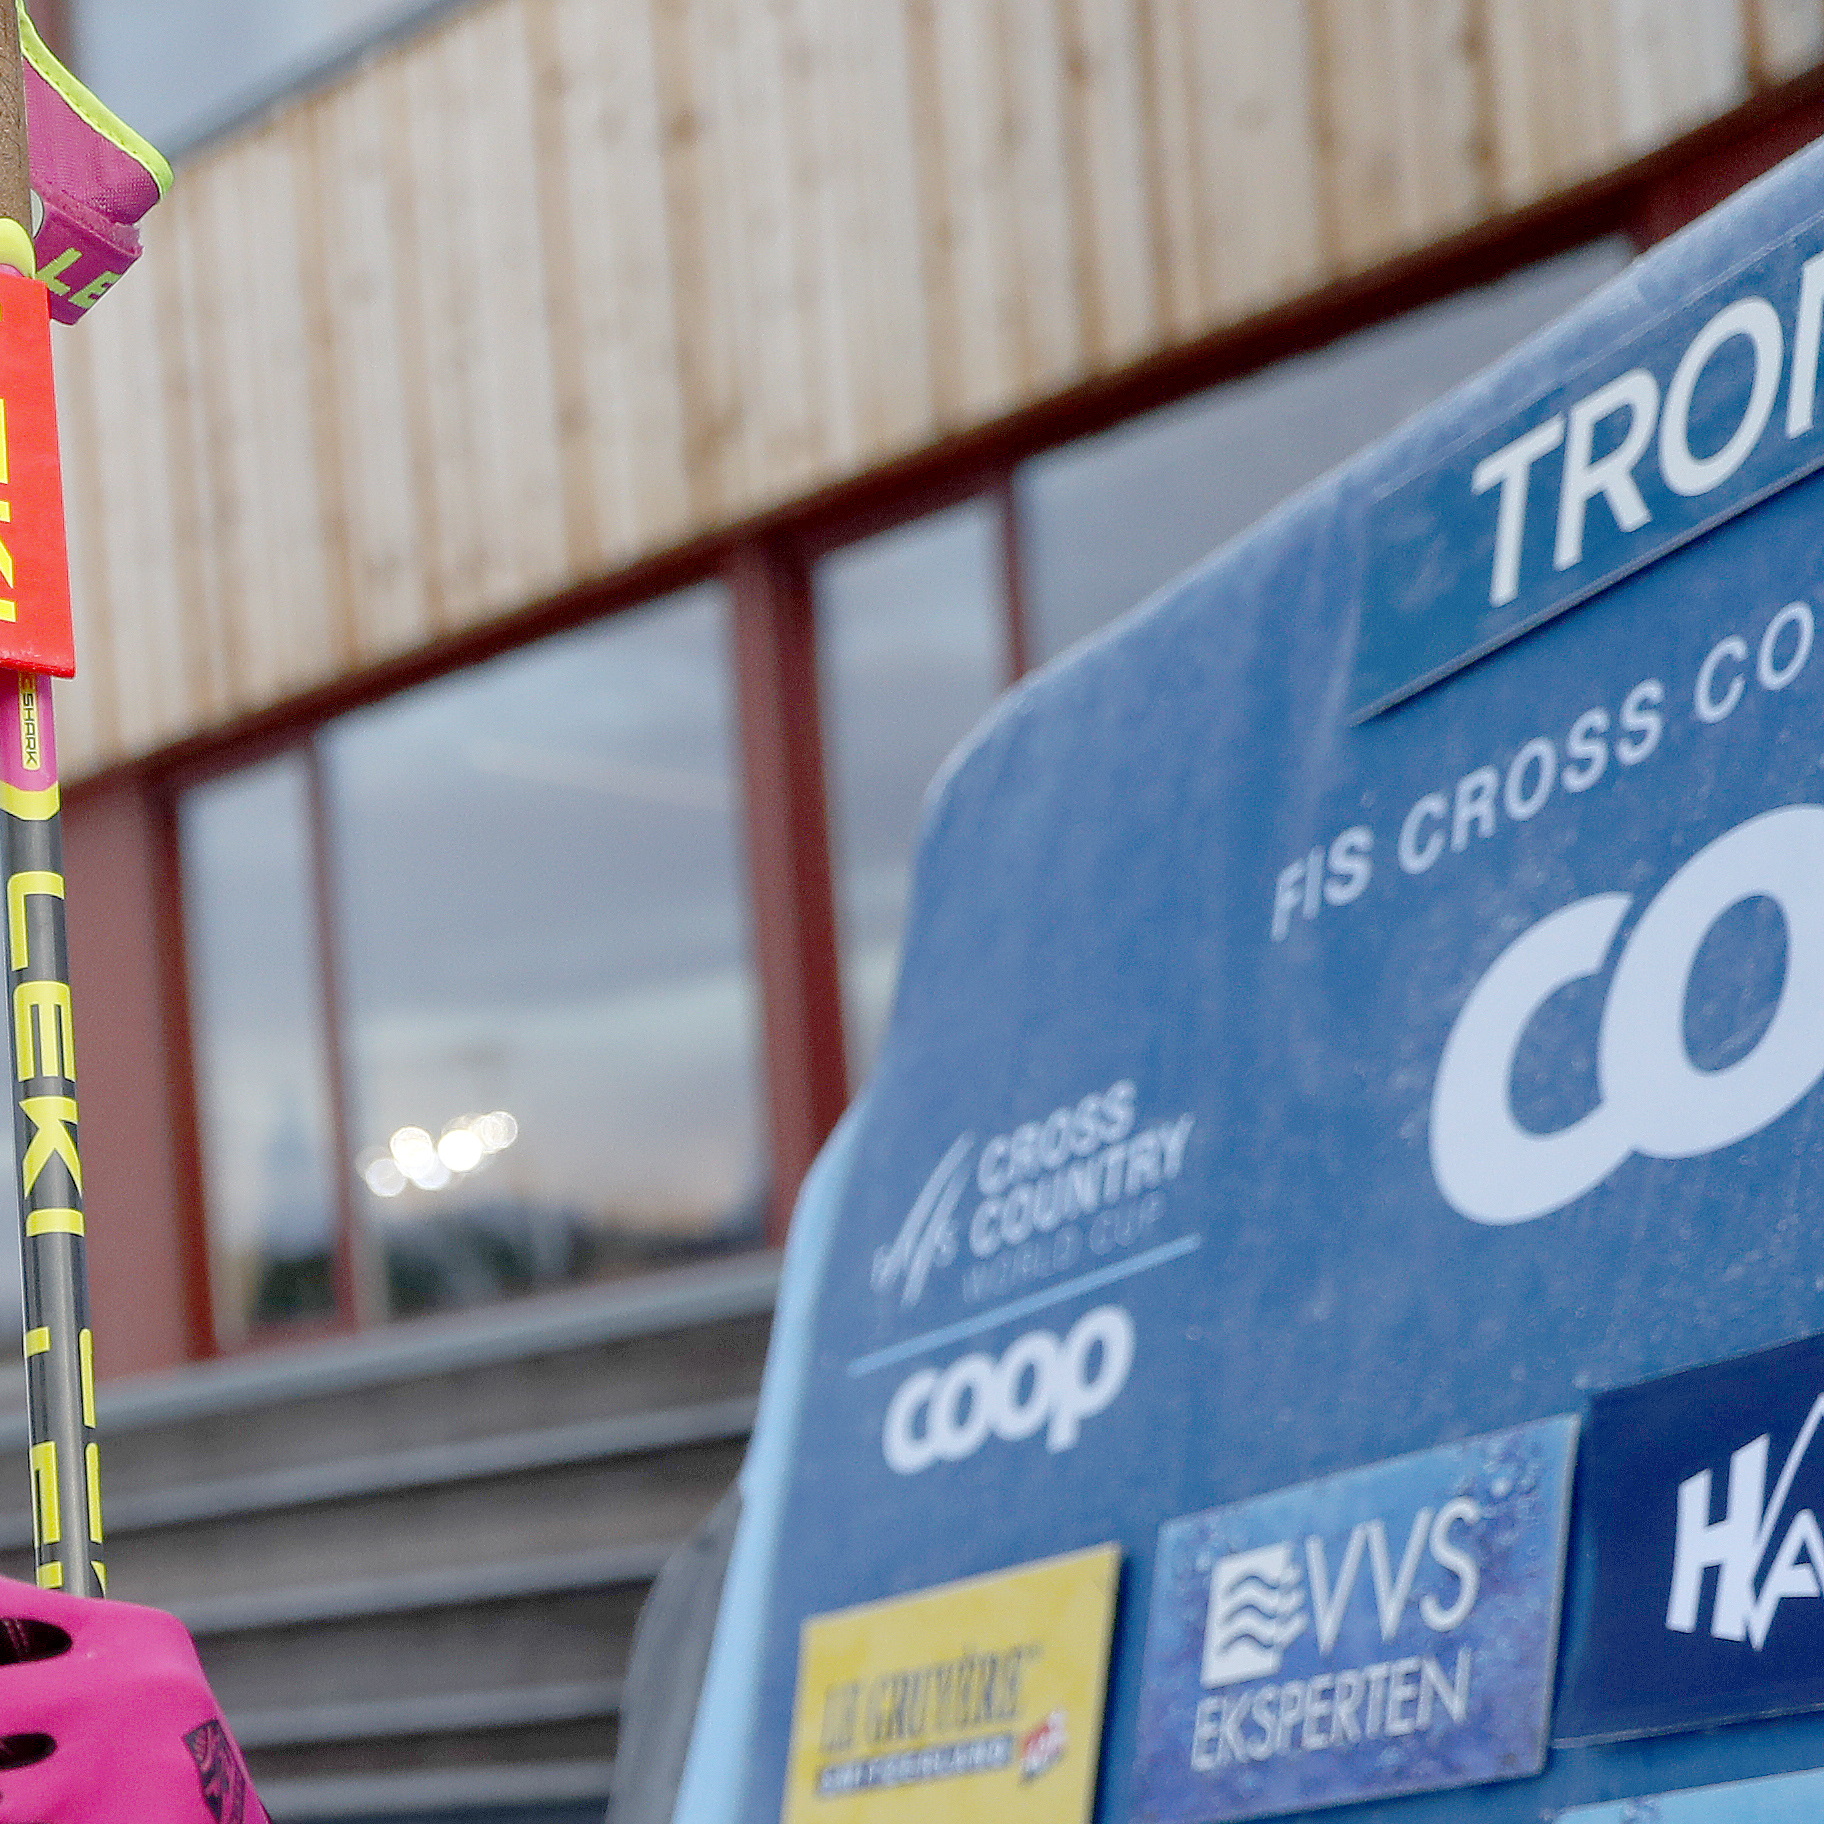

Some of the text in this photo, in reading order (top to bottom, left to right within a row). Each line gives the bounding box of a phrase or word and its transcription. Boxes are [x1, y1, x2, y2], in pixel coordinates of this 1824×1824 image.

[23, 693, 38, 765] SHARK
[1270, 824, 1375, 943] FIS
[1398, 678, 1666, 875] CROSS
[7, 871, 84, 1238] LEKI
[969, 1111, 1196, 1258] COUNTRY
[977, 1078, 1137, 1195] CROSS
[882, 1303, 1136, 1476] coop
[1306, 1499, 1481, 1656] VVS
[1191, 1647, 1472, 1771] EKSPERTEN
